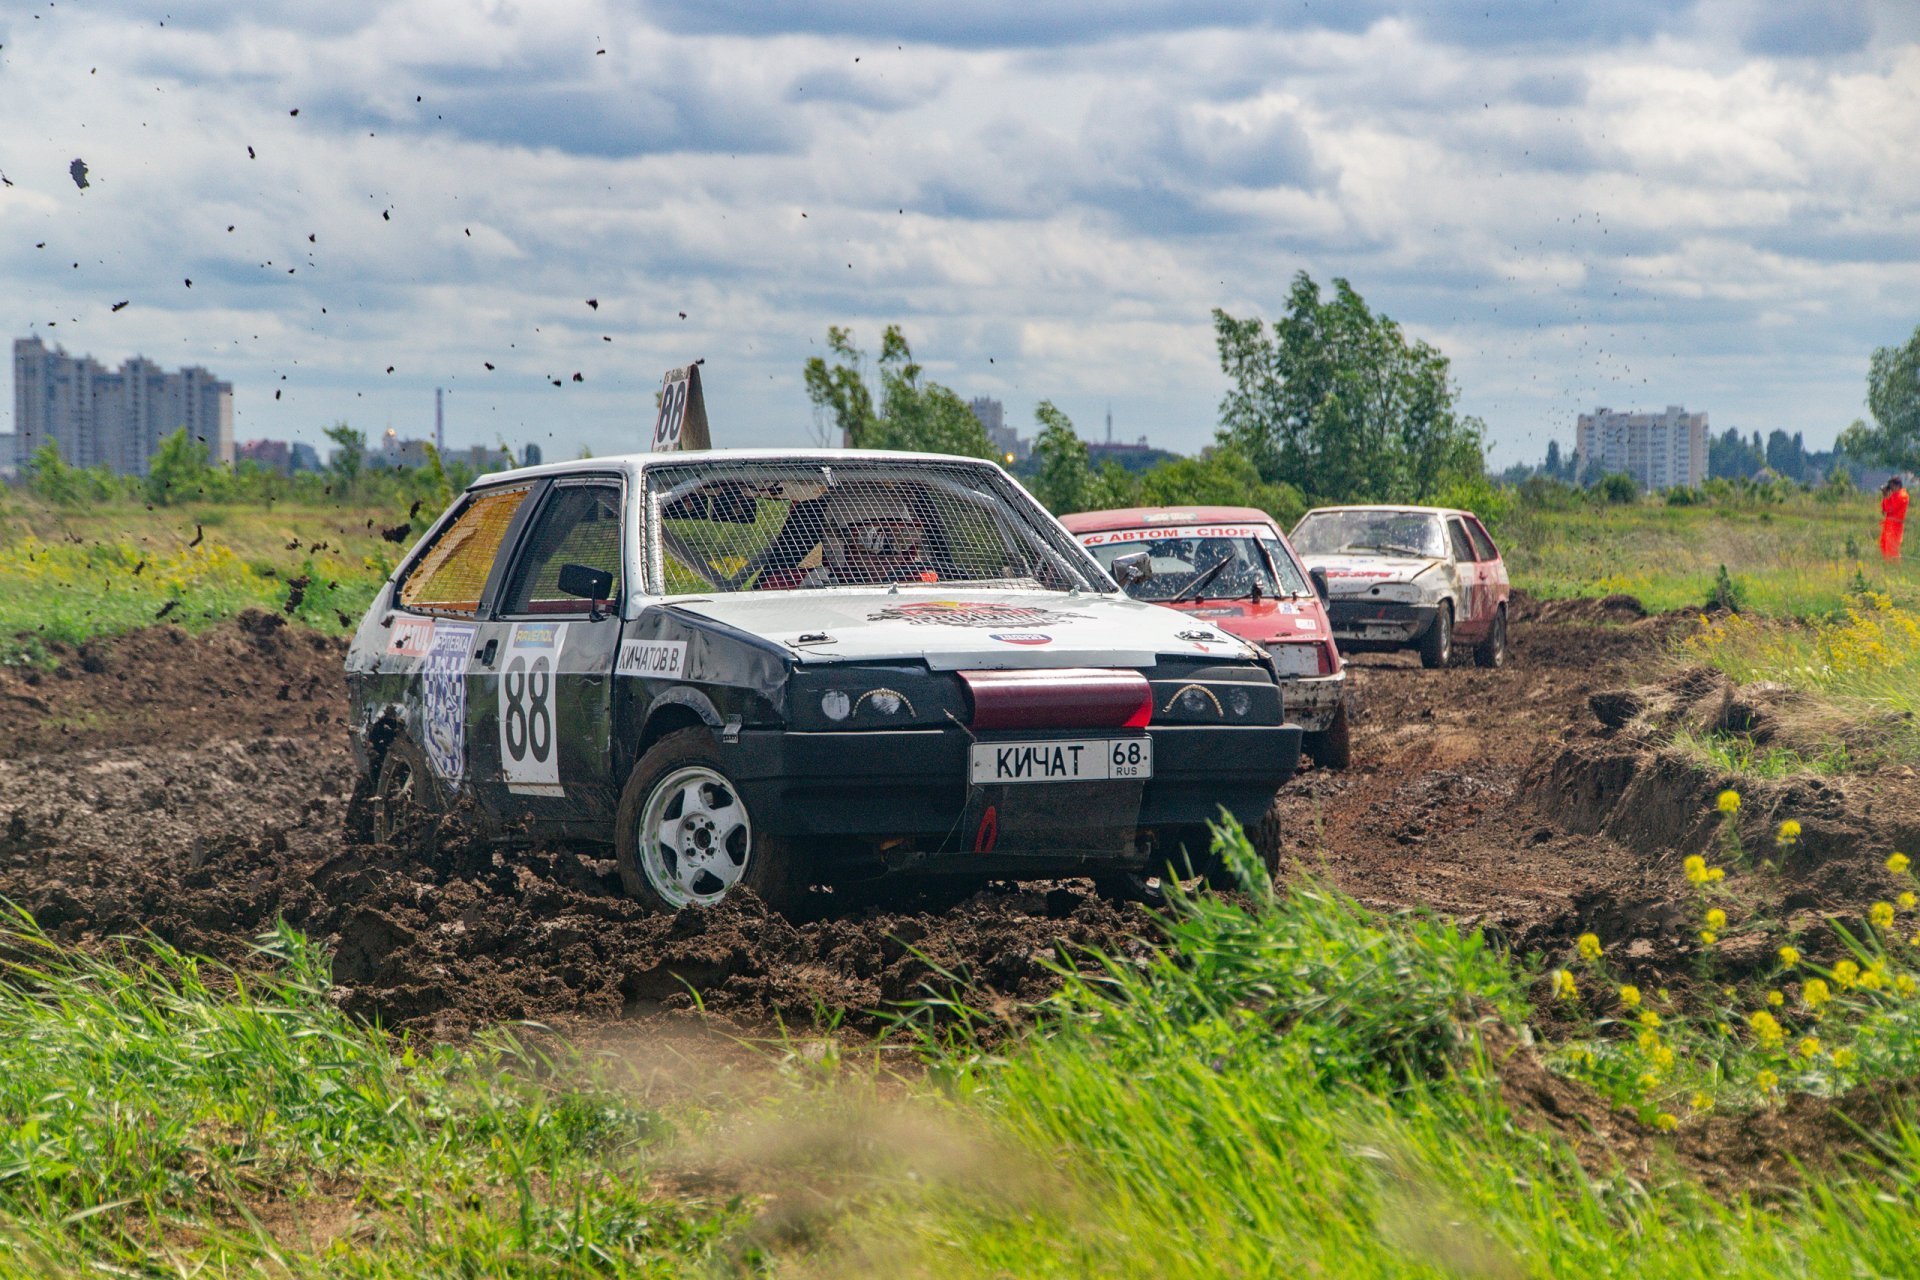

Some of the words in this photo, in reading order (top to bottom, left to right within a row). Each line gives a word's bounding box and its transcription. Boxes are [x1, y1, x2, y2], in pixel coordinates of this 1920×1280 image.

[657, 381, 686, 443] 88
[1109, 529, 1179, 543] АВТОМ
[619, 645, 668, 671] КИЧАТОВ
[669, 648, 680, 672] В.
[505, 656, 551, 763] 88
[997, 746, 1084, 778] КИЧАТ
[1112, 743, 1141, 765] 68
[1116, 767, 1137, 776] RUS
